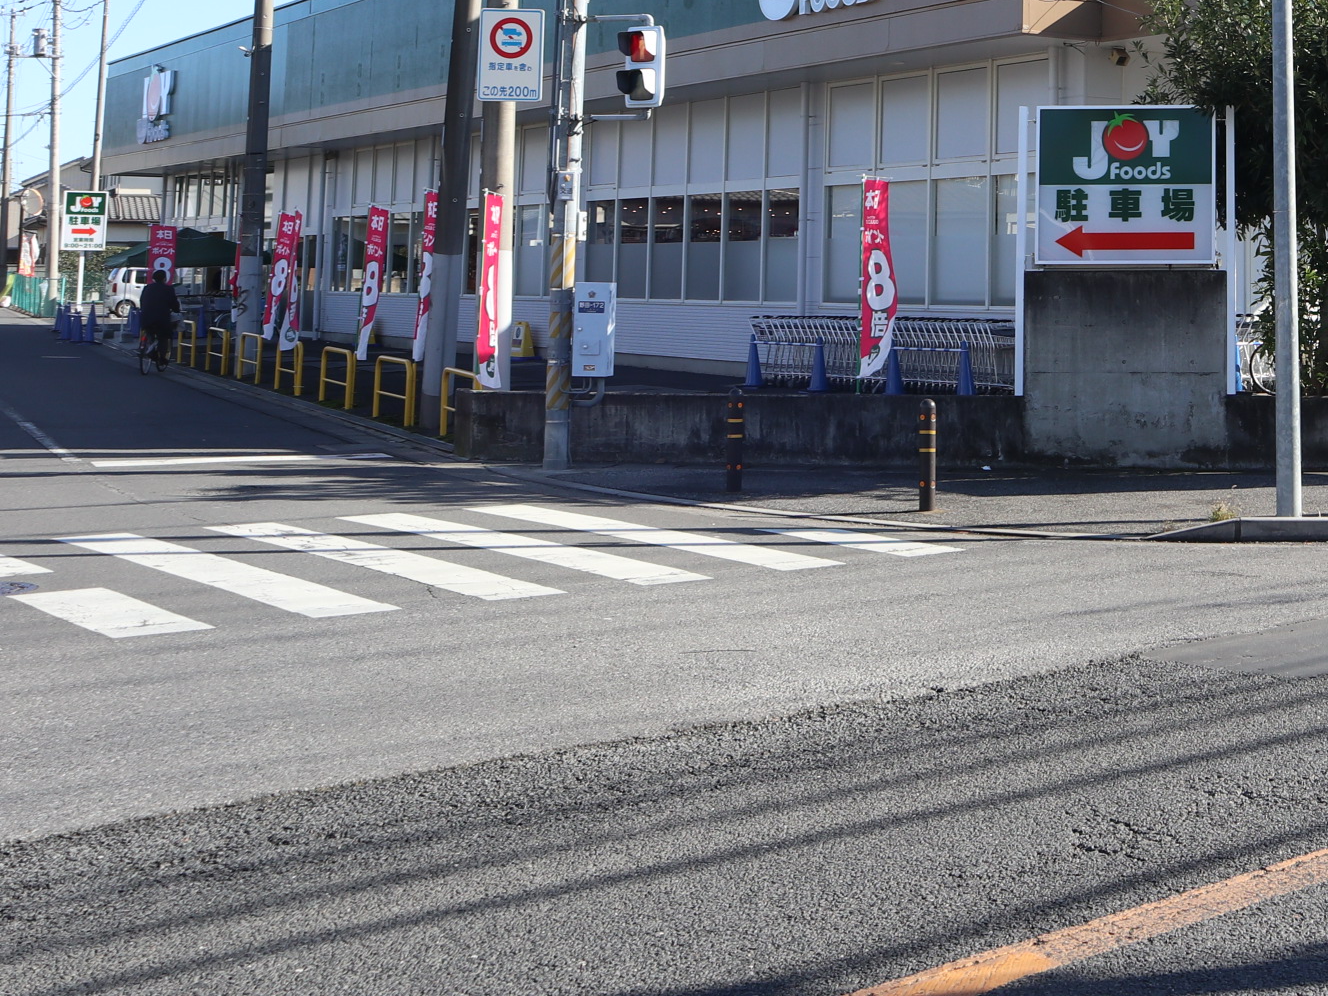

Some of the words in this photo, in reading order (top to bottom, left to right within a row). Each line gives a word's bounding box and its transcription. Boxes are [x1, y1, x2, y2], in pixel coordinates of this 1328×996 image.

[488, 62, 532, 71] 指定車を含む
[482, 85, 537, 97] この先200m
[1055, 188, 1196, 222] 駐車場
[68, 216, 101, 226] 駐車場
[156, 230, 173, 239] 本日
[152, 247, 176, 255] ポイント
[866, 249, 896, 311] 8
